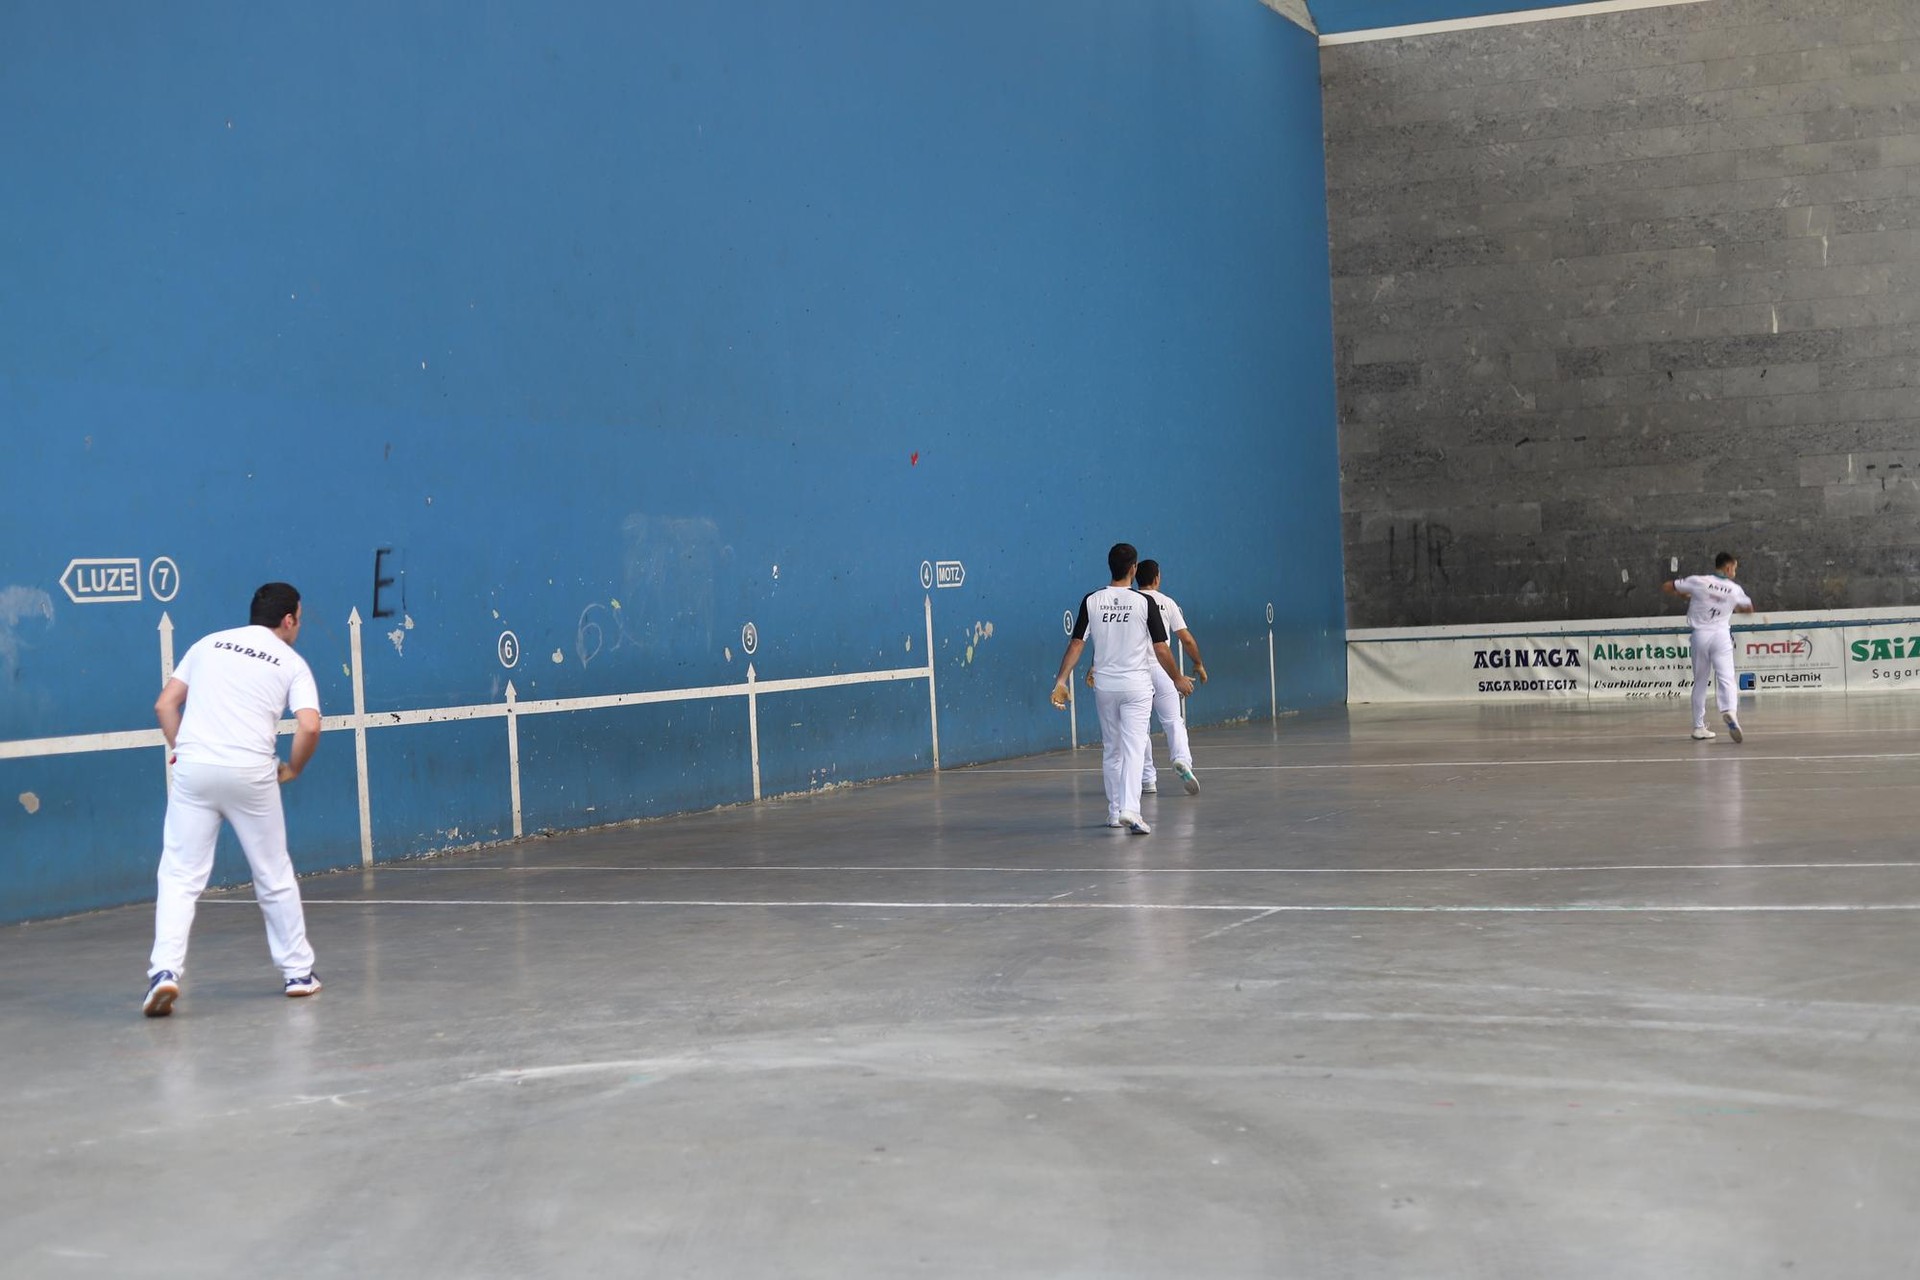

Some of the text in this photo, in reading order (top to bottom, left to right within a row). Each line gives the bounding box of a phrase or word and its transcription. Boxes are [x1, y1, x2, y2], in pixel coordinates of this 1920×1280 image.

[77, 568, 135, 592] LUZE
[158, 568, 170, 590] 7
[373, 548, 395, 618] E
[938, 567, 961, 582] MOTZ
[1102, 612, 1130, 623] EPLE
[214, 641, 281, 667] USURBIL
[504, 640, 513, 659] 6
[1593, 643, 1691, 660] Alkartasu
[1746, 641, 1804, 654] maiz
[1594, 680, 1672, 688] Usurbildarron
[1760, 672, 1821, 683] ventamix
